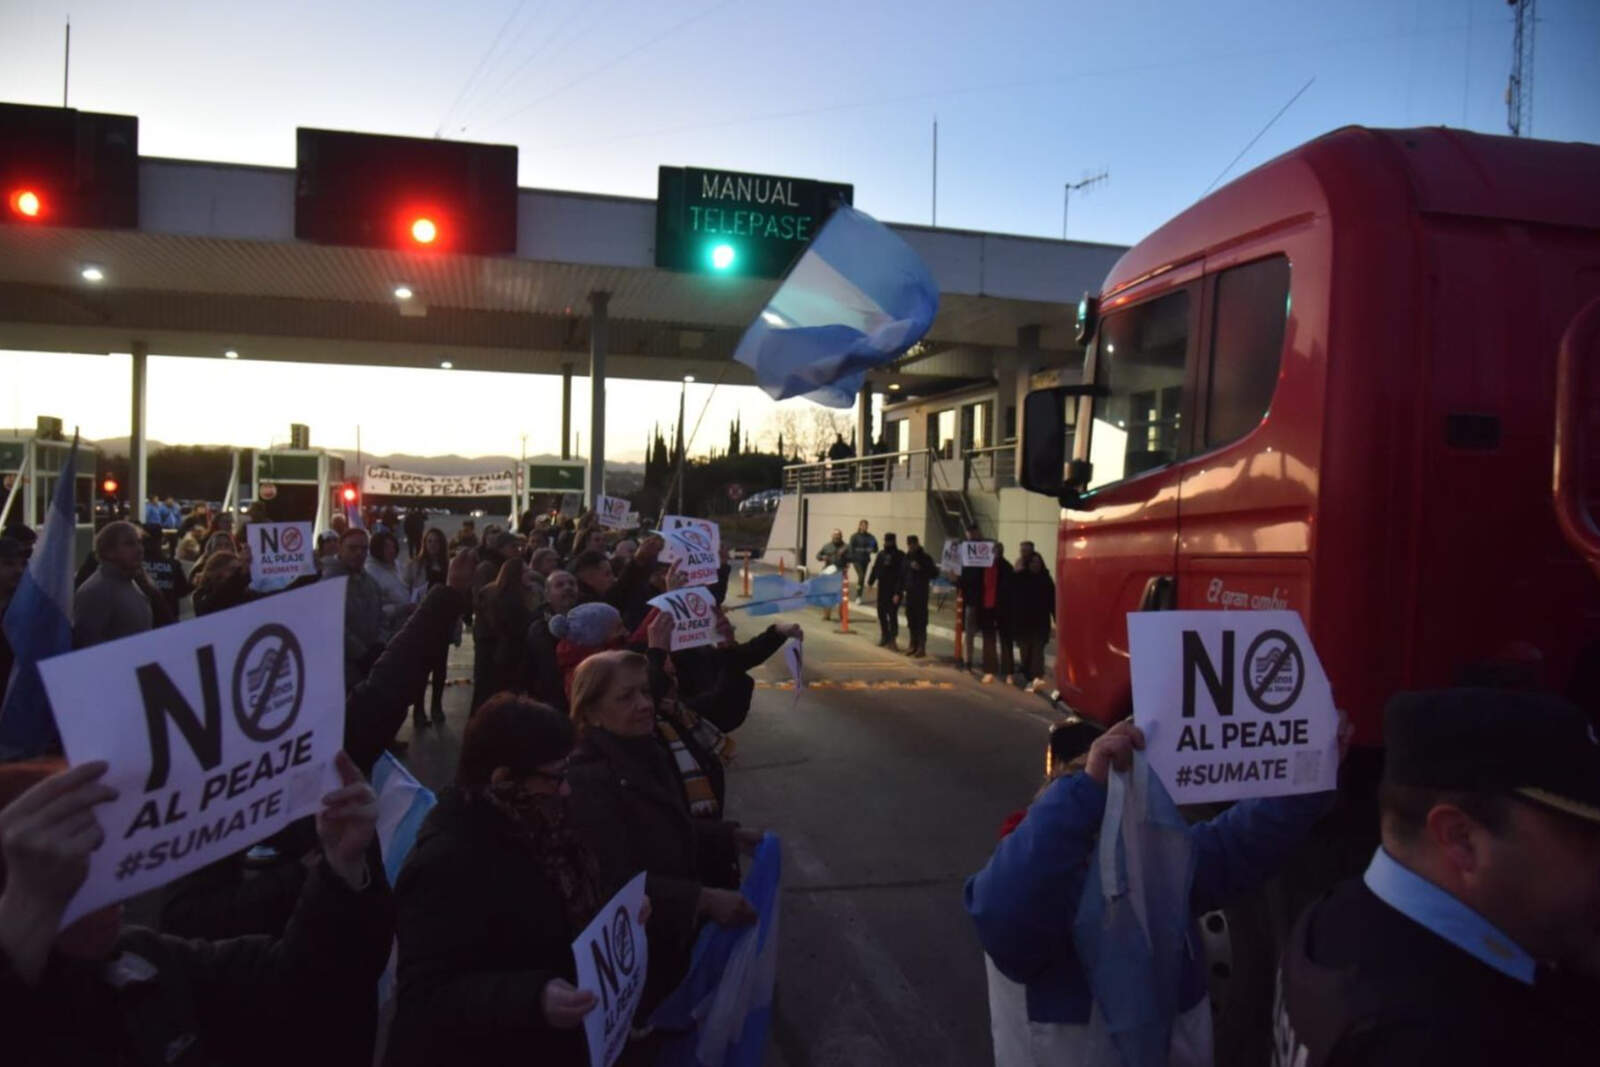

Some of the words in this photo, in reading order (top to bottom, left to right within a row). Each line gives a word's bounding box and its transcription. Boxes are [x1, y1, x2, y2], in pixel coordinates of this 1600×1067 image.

[702, 174, 799, 207] MANUAL
[690, 206, 812, 241] TELEPASE
[431, 482, 487, 495] PEAJE
[260, 527, 303, 554] NO
[274, 553, 304, 563] PEAJE
[665, 593, 707, 620] NO
[1182, 629, 1305, 718] NO
[135, 623, 304, 793] NO
[1176, 725, 1214, 751] AL
[1222, 719, 1309, 749] PEAJE
[123, 790, 187, 839] AL
[200, 731, 313, 812] PEAJE
[1176, 759, 1288, 787] #SUMATE
[115, 789, 283, 881] #SUMATE
[591, 905, 635, 1012] NO
